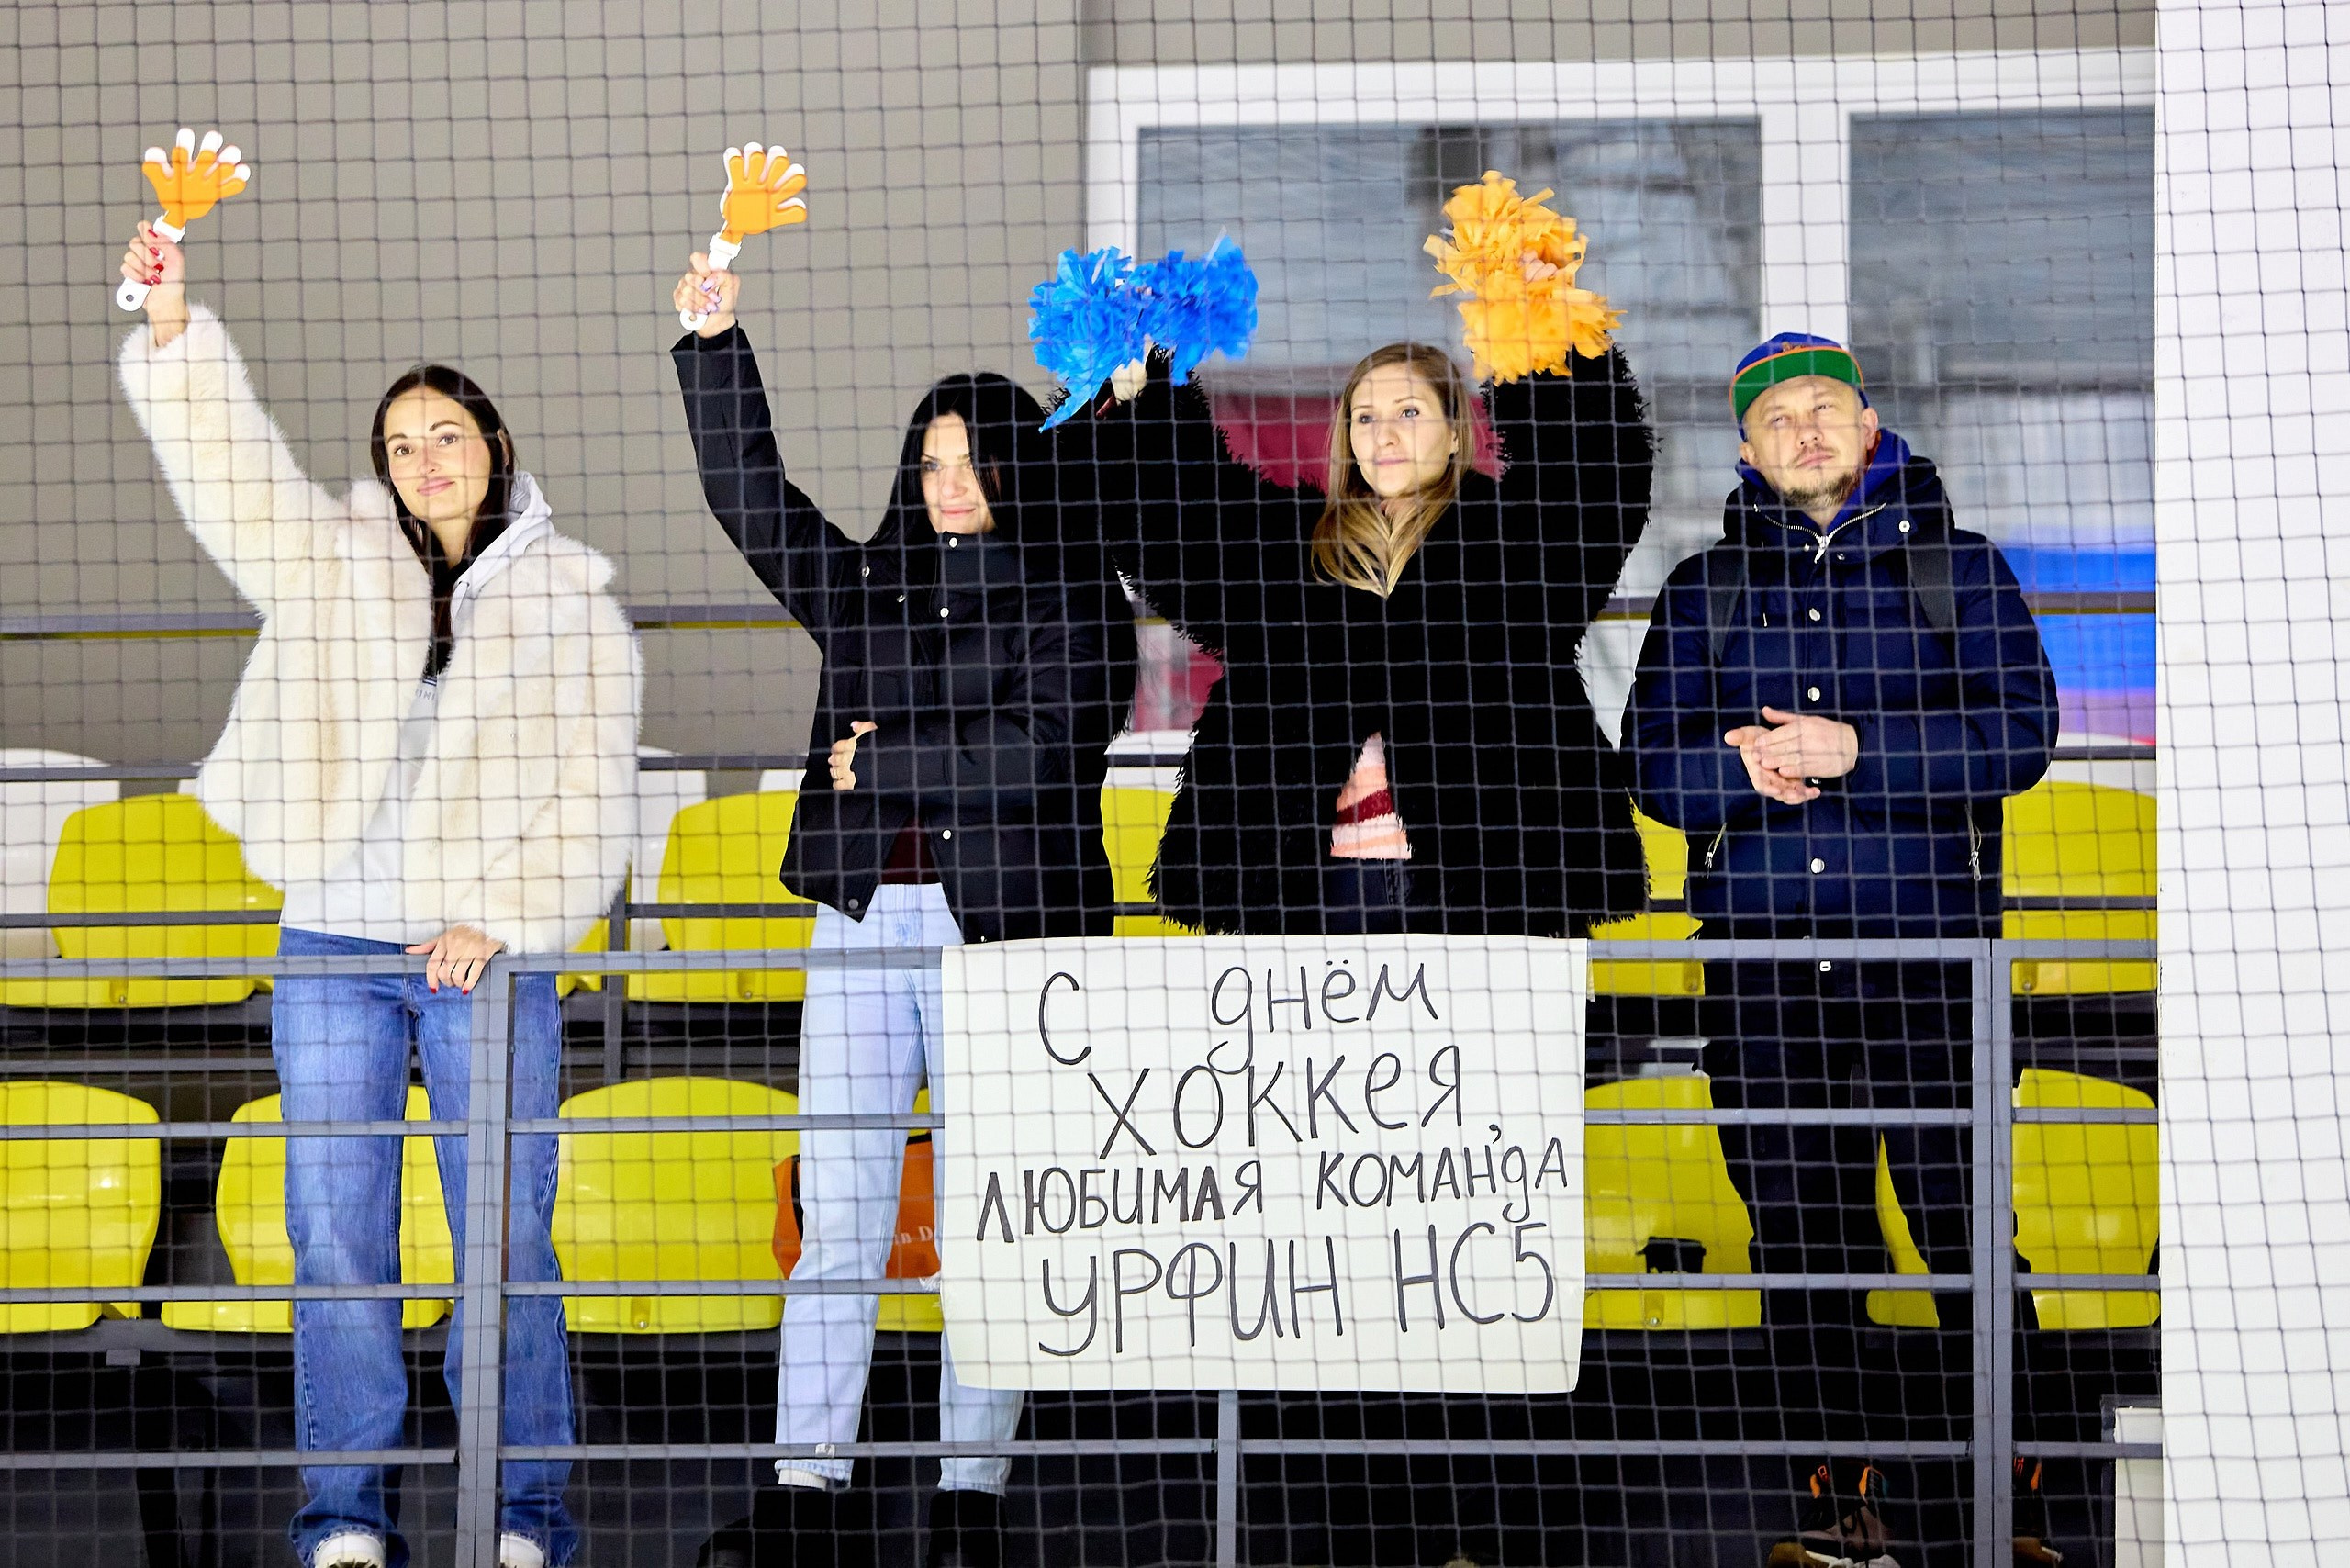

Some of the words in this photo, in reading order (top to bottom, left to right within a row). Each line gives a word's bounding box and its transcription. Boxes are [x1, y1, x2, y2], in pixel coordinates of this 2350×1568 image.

[1038, 971, 1091, 1066] С
[976, 1159, 1263, 1243] ЛЮБИМАЯ
[1038, 1235, 1344, 1357] УРФИН
[1393, 1222, 1555, 1333] НС5
